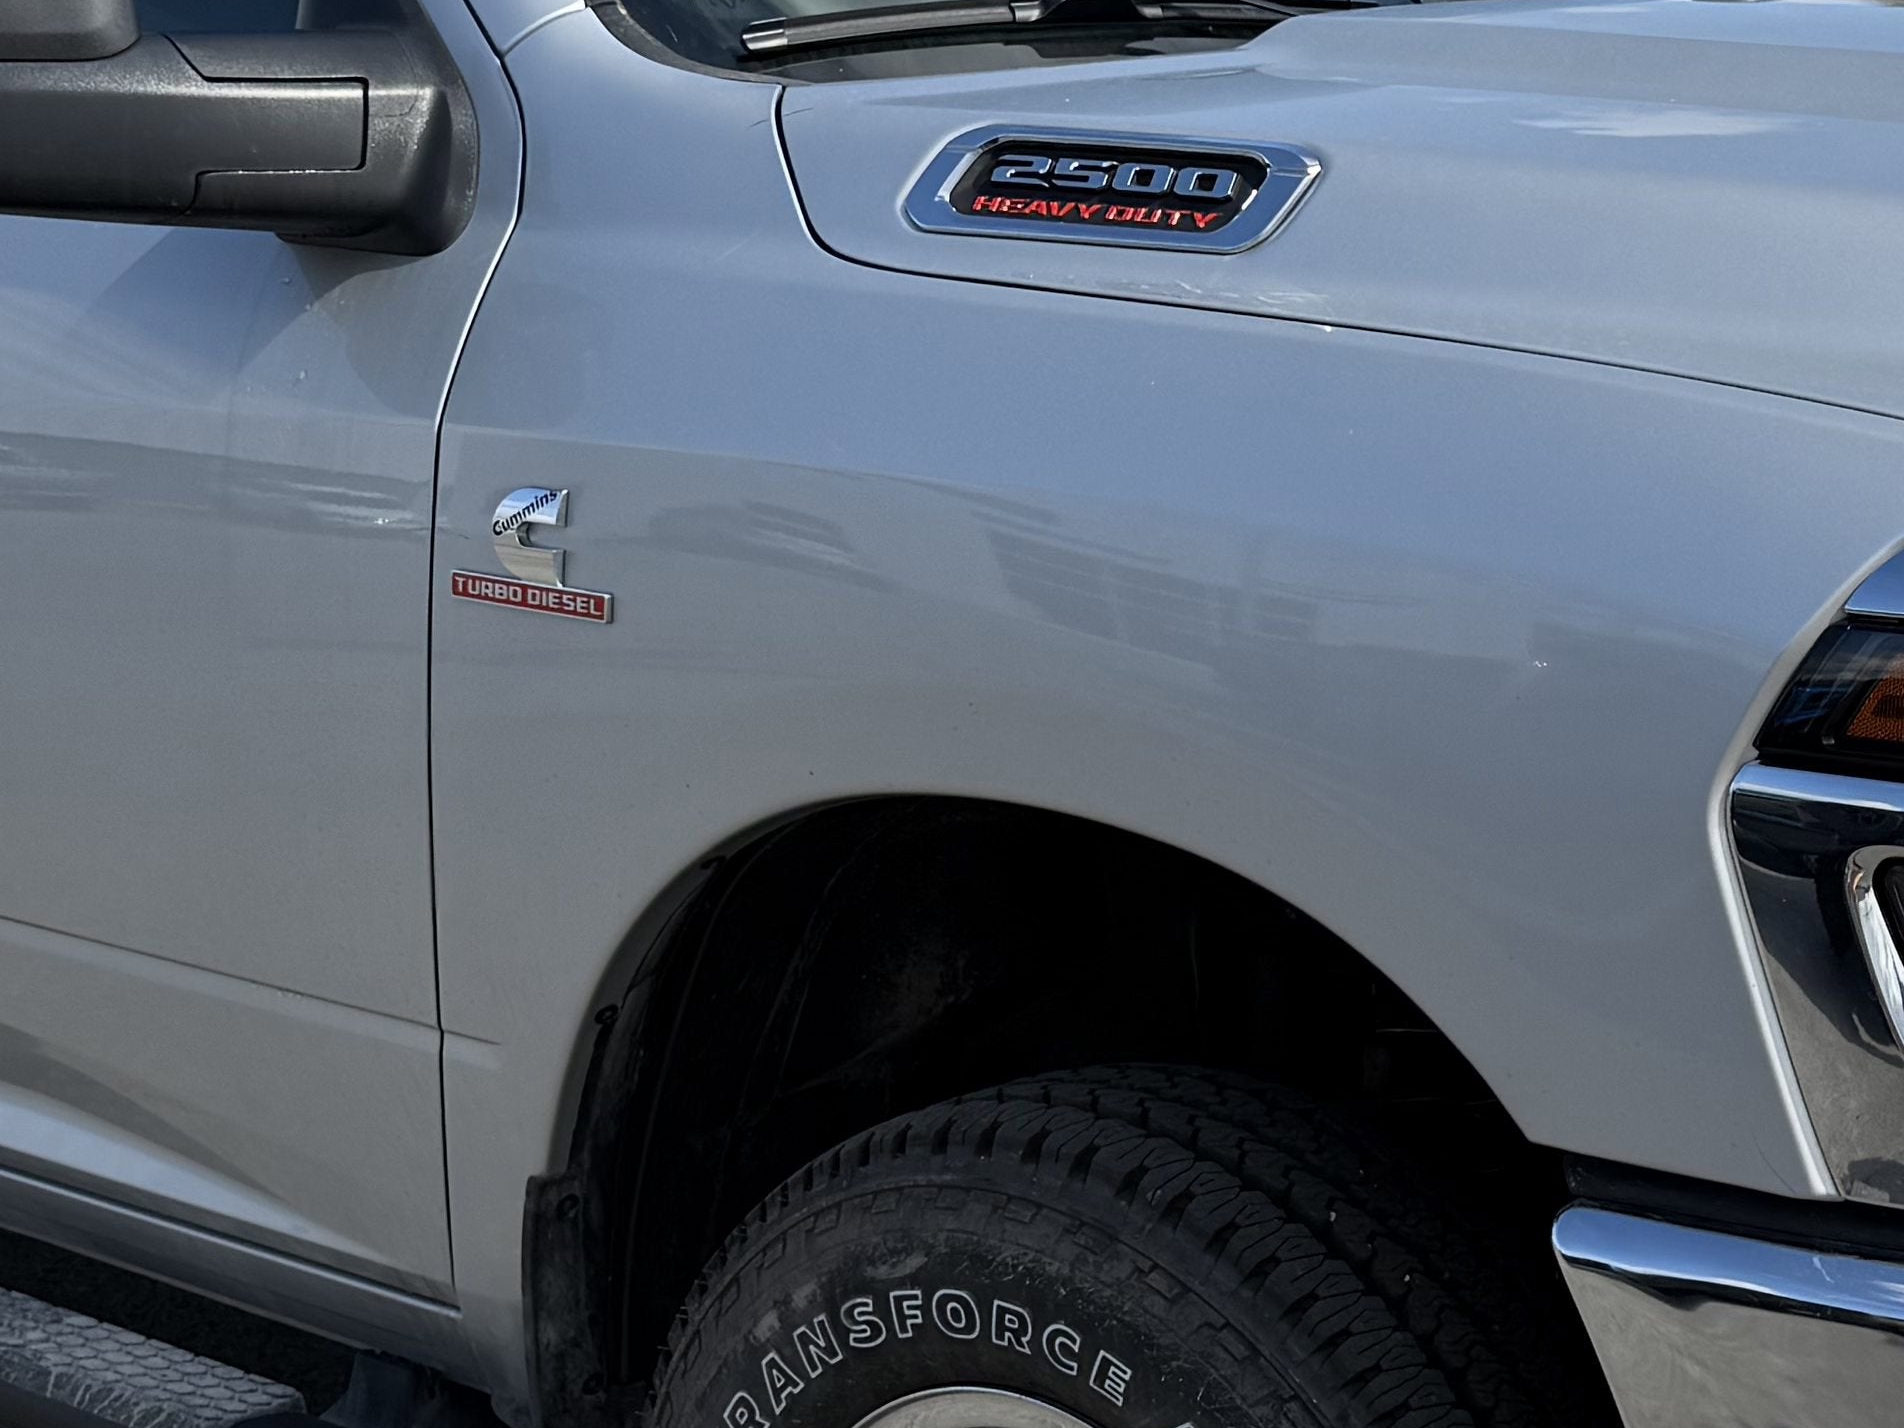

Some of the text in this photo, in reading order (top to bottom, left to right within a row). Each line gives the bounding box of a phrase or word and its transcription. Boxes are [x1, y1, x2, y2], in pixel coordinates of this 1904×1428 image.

[990, 154, 1243, 203] 2500
[971, 195, 1225, 229] HEAVY DUTY
[492, 489, 559, 537] Cummins
[454, 575, 604, 616] TURBO DIESEL
